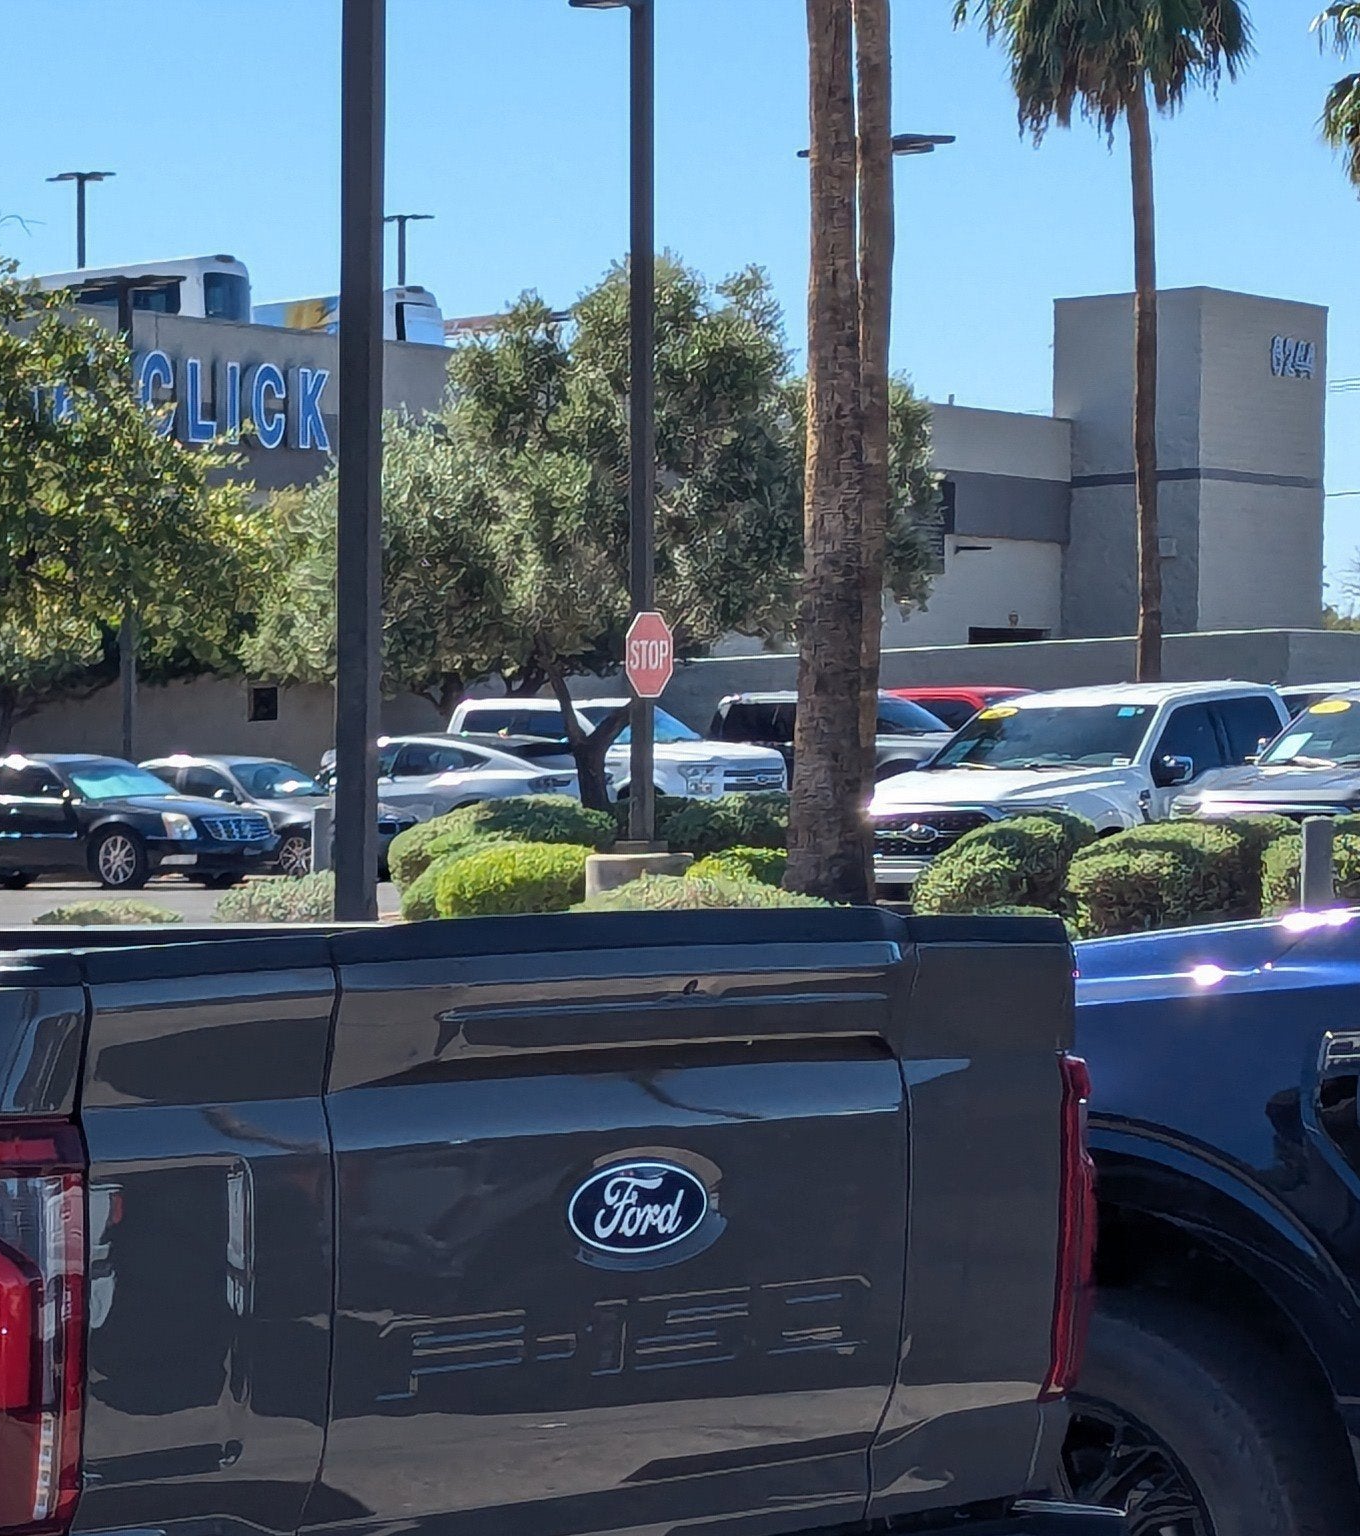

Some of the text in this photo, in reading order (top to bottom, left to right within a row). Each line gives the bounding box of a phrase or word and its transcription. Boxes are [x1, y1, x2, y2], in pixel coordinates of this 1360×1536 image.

[139, 350, 332, 450] CLICK
[629, 640, 669, 670] STOP
[593, 1176, 685, 1239] Ford
